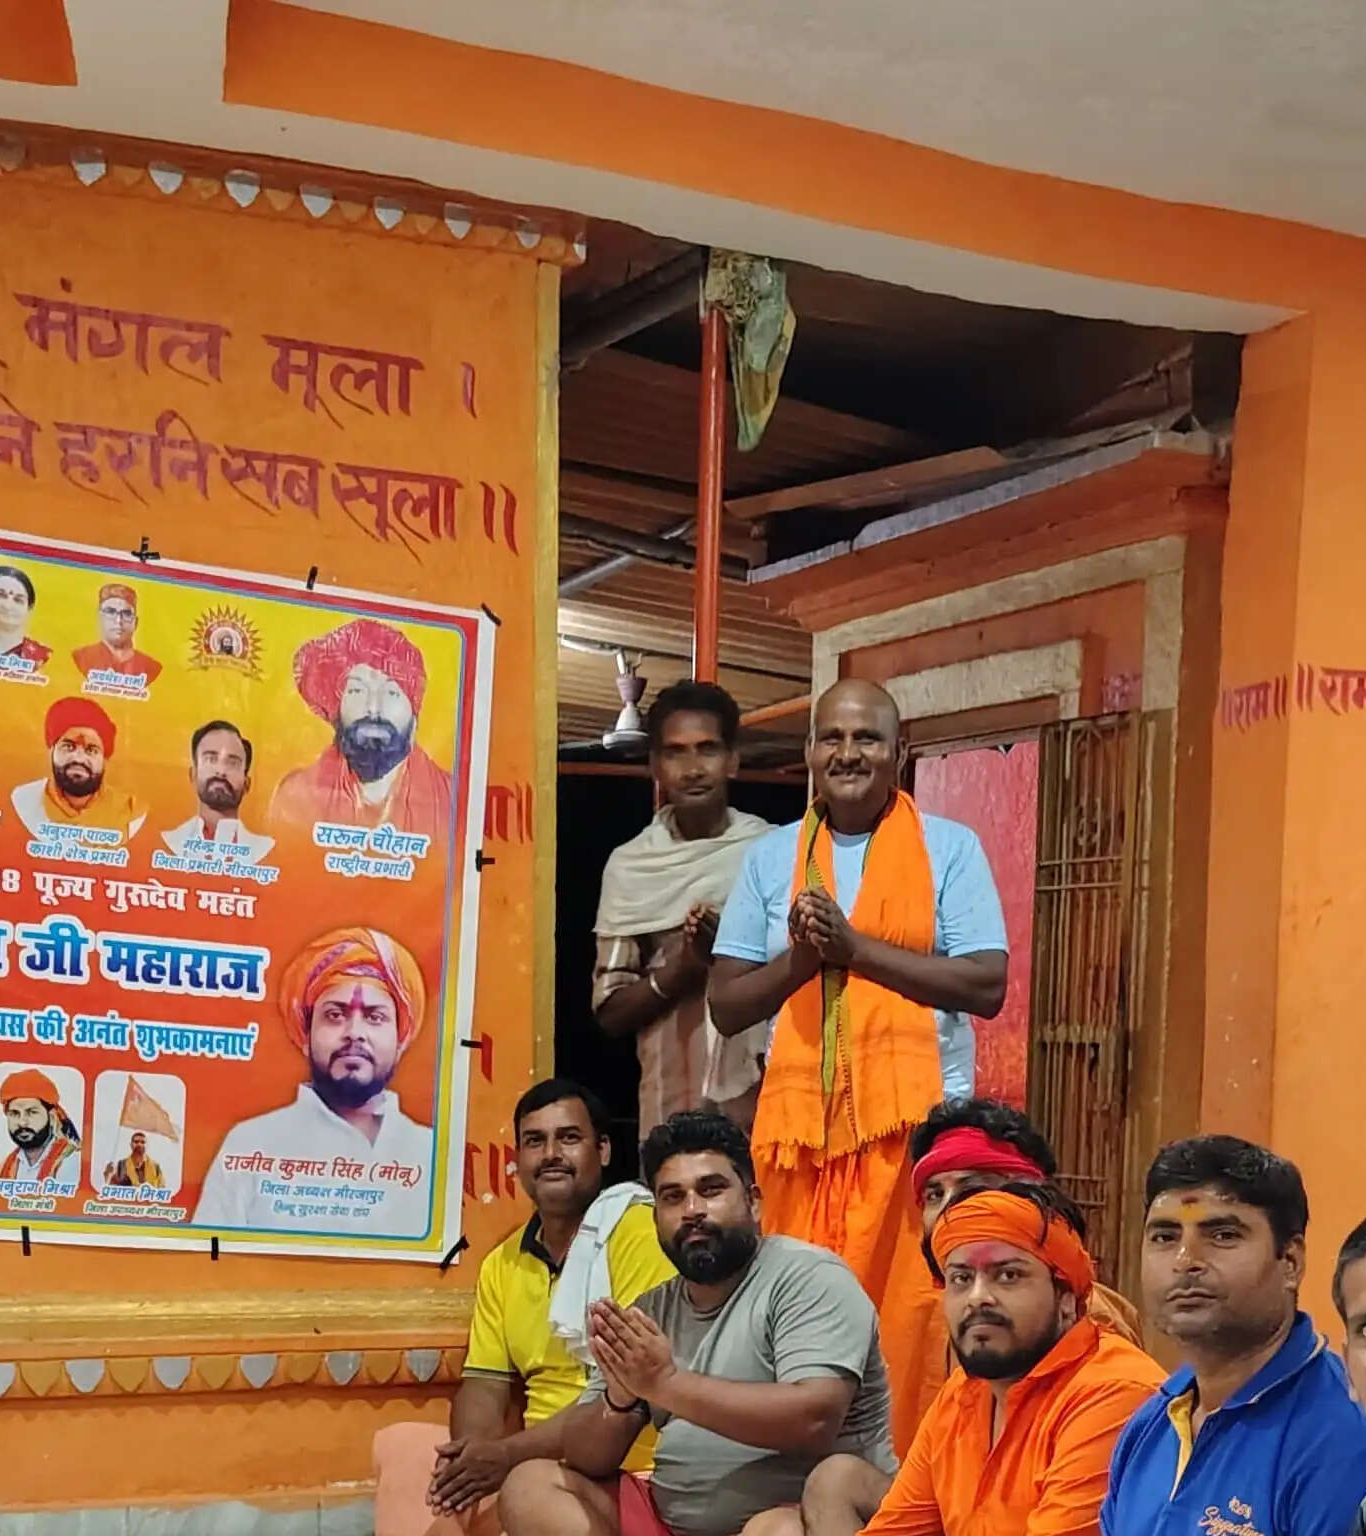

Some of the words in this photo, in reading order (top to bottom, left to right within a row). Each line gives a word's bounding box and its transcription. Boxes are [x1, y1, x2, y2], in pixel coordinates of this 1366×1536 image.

[14, 278, 232, 385] मंगल
[261, 334, 425, 430] मूला
[54, 410, 218, 507] हरनि
[220, 444, 325, 519] सब
[331, 461, 463, 565] सूला
[327, 854, 371, 874] राष्ट्रीय
[373, 860, 412, 877] प्रभारी
[372, 825, 428, 855] चौहान
[32, 870, 97, 907] पूज्य
[196, 887, 259, 920] महंत
[21, 920, 89, 978] जी
[102, 938, 265, 995] महाराज
[34, 1006, 67, 1043] की
[74, 1010, 130, 1050] अनंत
[134, 1024, 259, 1061] शुभकामनाएं
[224, 1150, 276, 1174] राजीव
[278, 1157, 328, 1181] कुमार
[331, 1156, 365, 1179] सिंह
